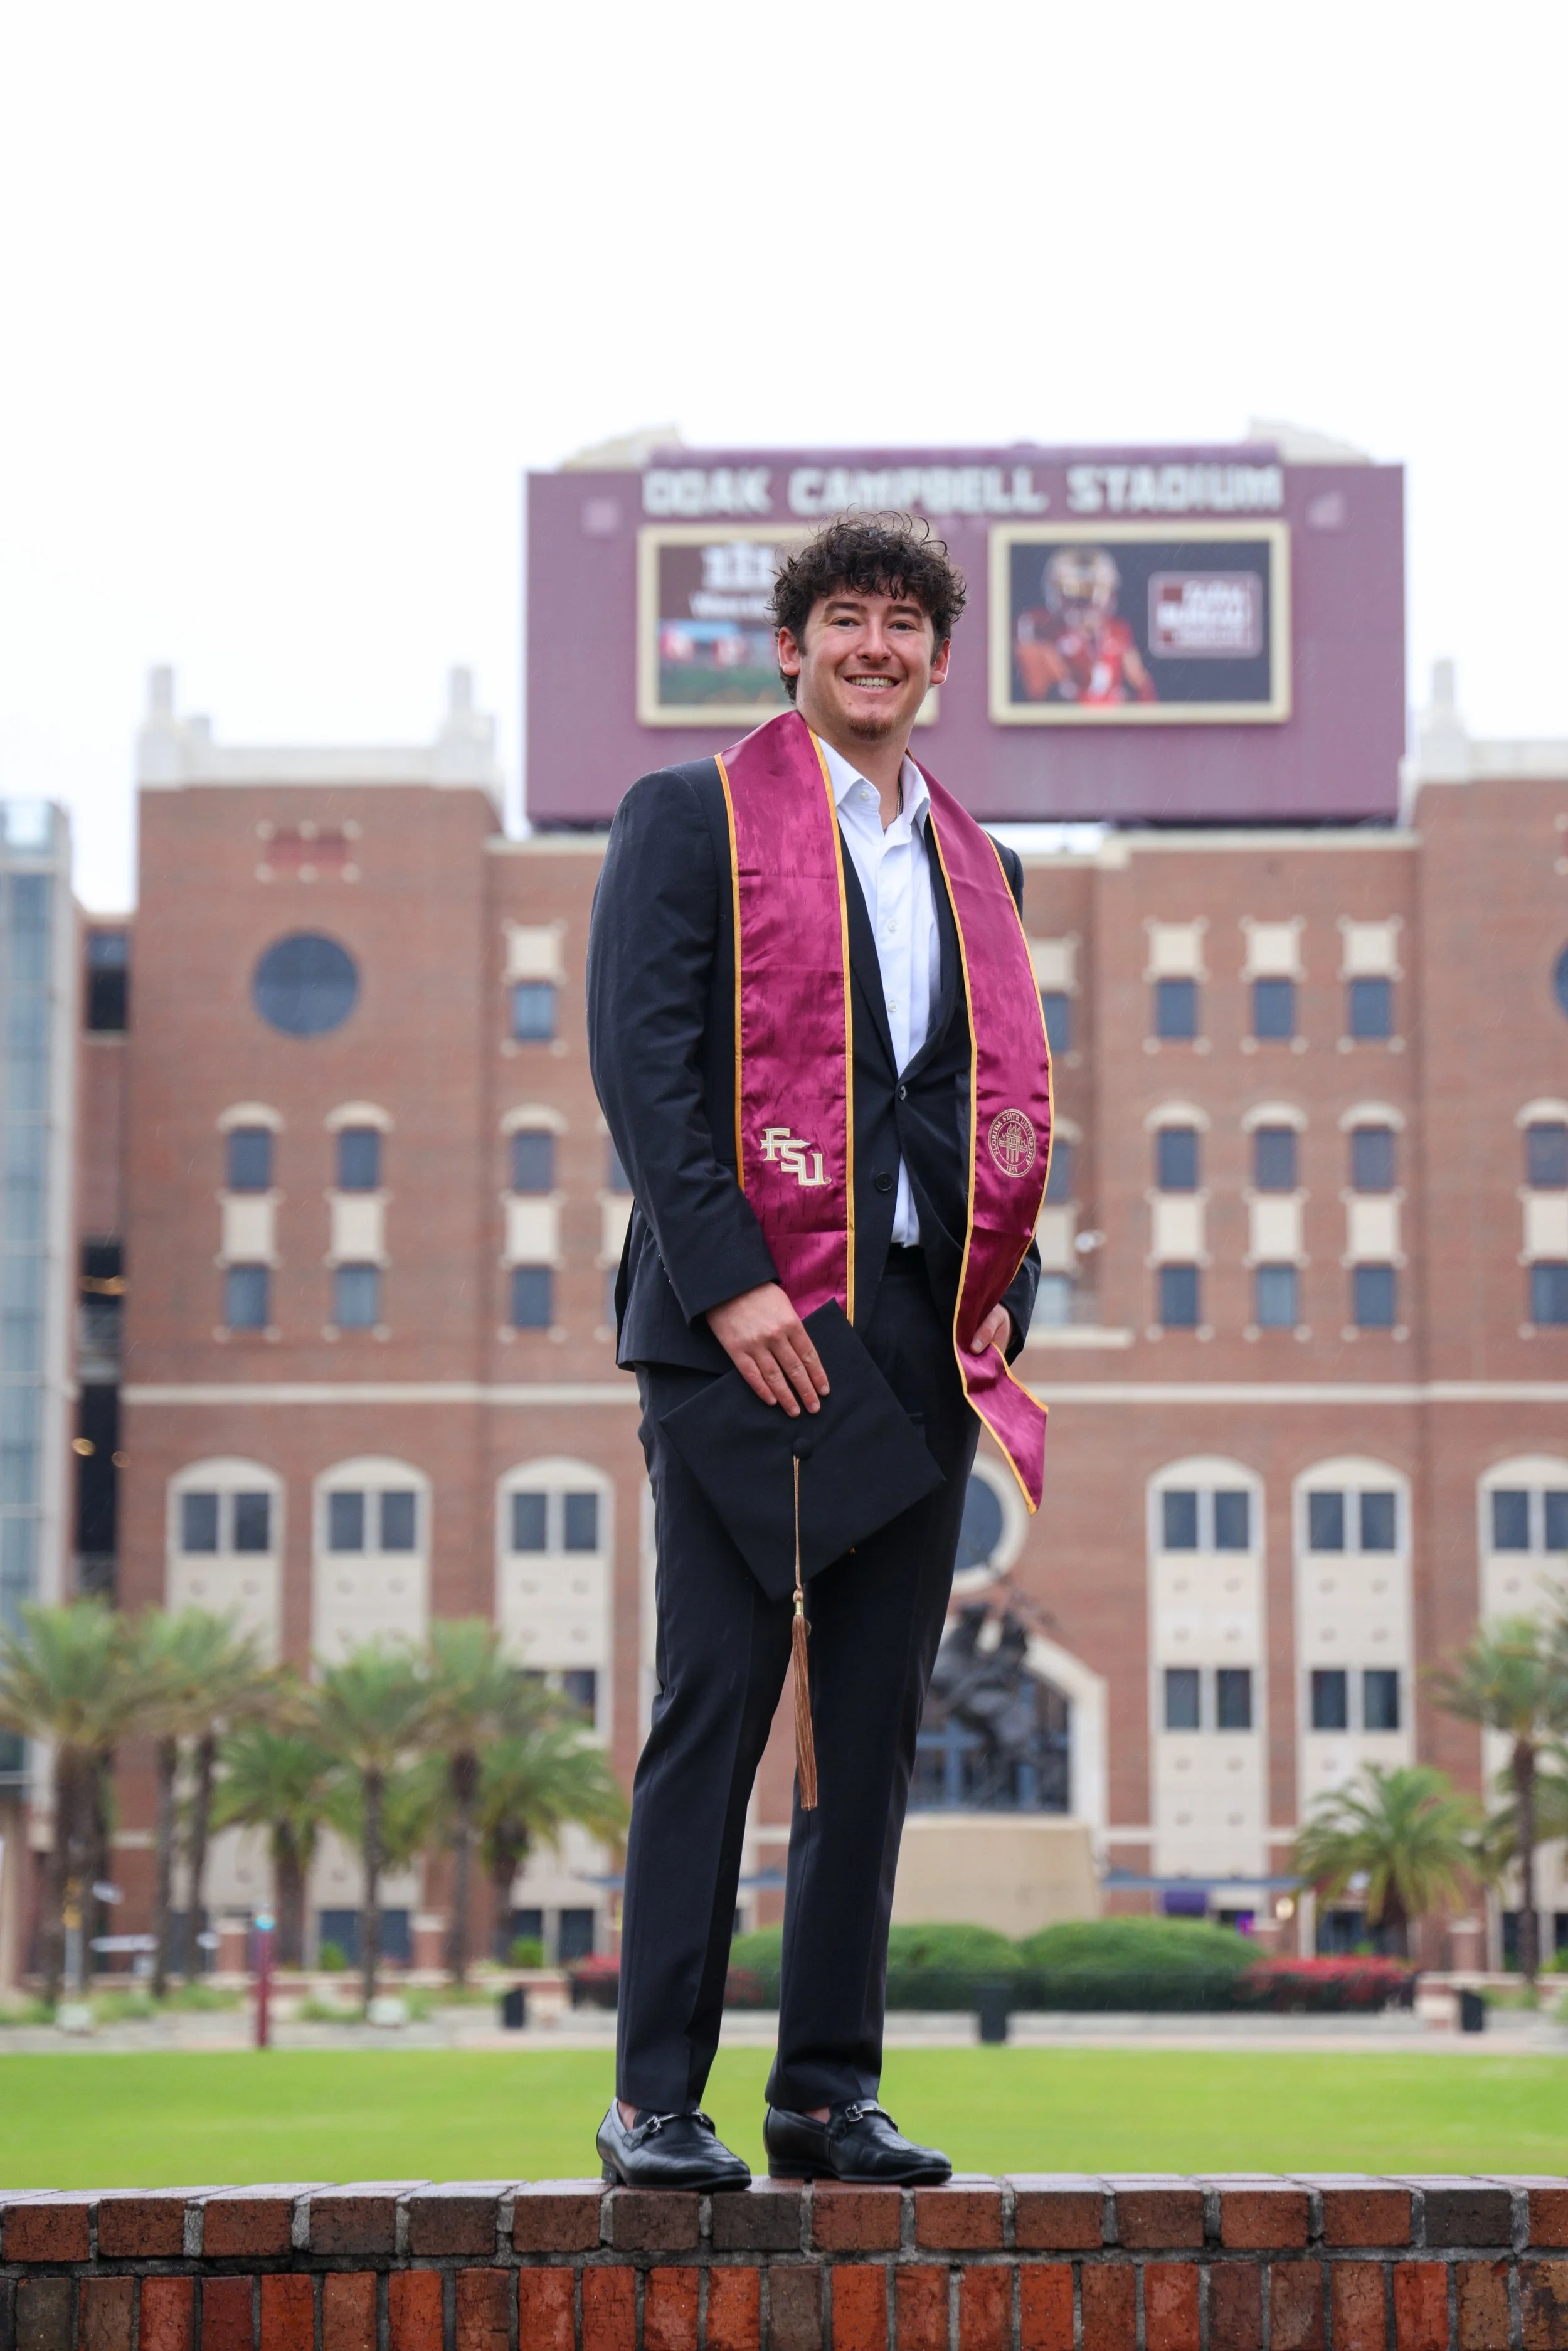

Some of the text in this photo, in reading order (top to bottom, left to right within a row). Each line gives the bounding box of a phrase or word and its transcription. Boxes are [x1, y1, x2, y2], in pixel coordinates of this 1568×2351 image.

[642, 464, 1283, 517] DOAK CAMPBELL STADIUM
[760, 1128, 827, 1186] FSU
[991, 1113, 1034, 1165] FLORIDA STATE UNIVERSITY
[1006, 1165, 1018, 1173] 1851
